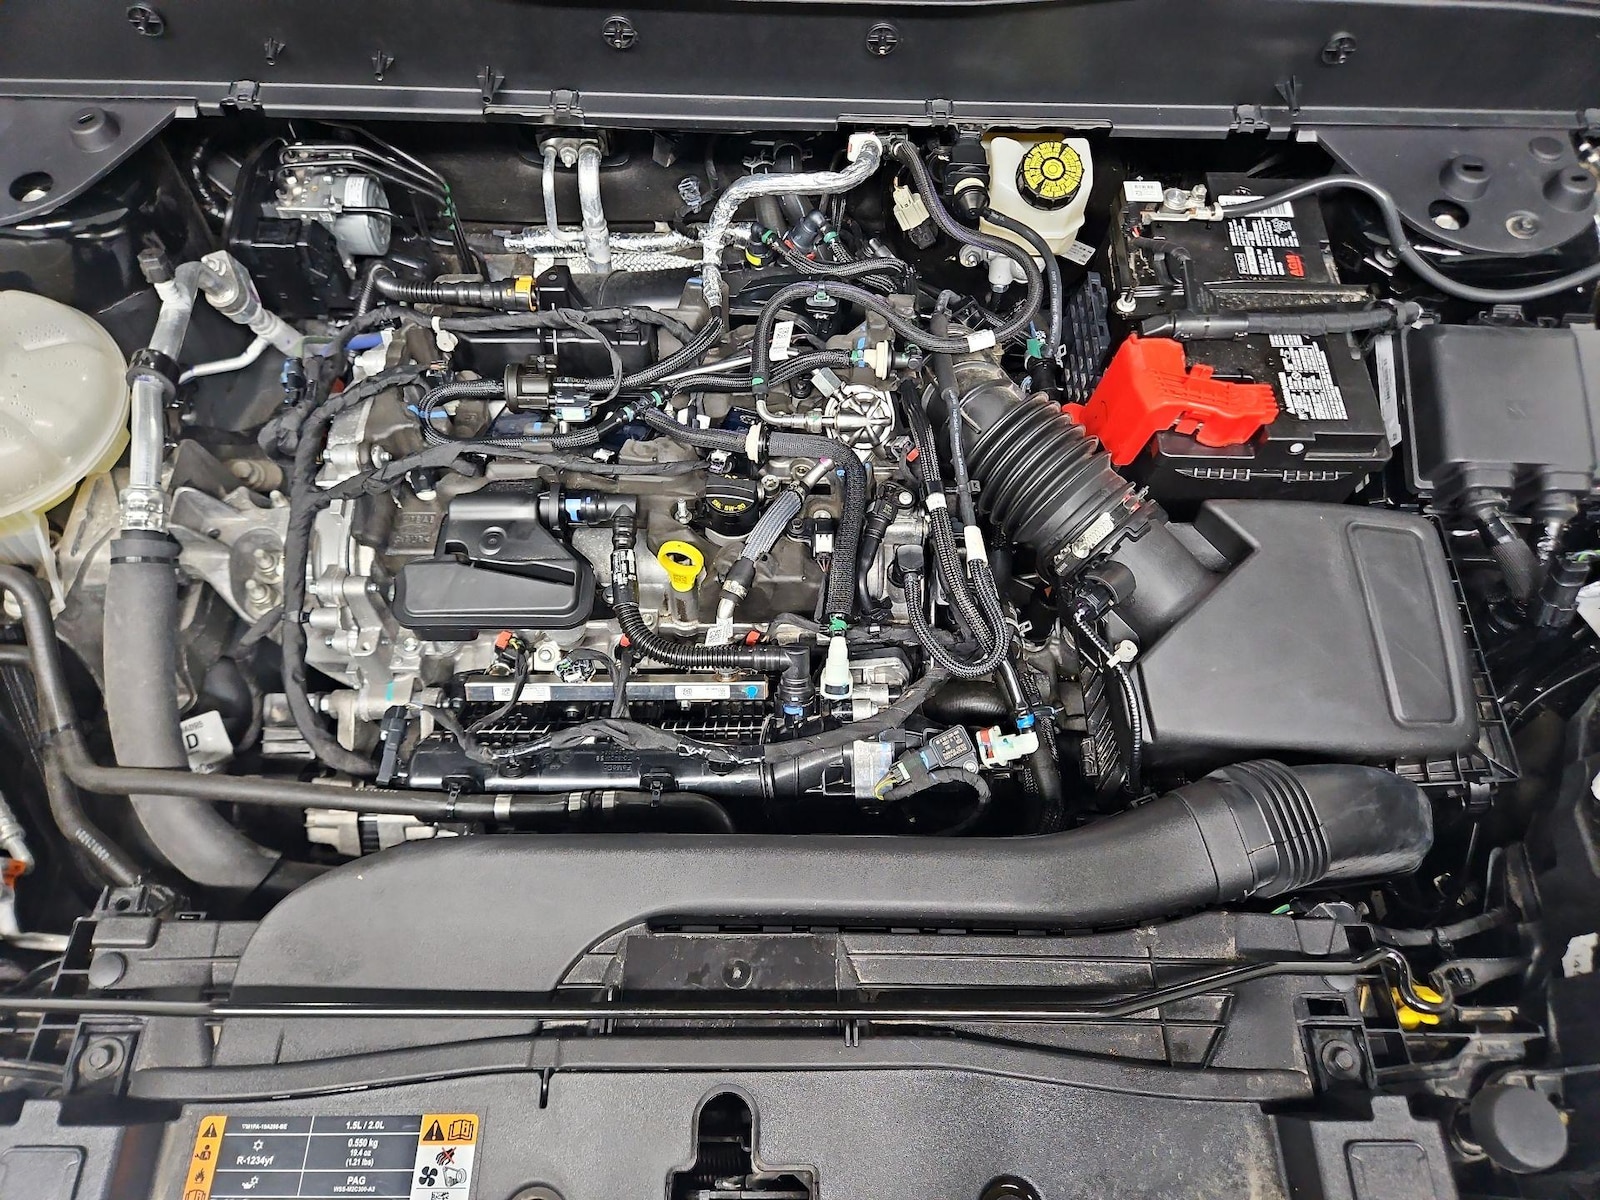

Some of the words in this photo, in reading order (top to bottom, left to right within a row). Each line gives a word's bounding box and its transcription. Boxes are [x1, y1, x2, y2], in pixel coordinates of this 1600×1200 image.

[346, 1121, 362, 1130] 1.5L
[368, 1121, 385, 1130] 2.0L
[348, 1138, 367, 1148] 0.550
[368, 1138, 379, 1150] kg
[236, 1155, 274, 1167] R-1234yf
[347, 1176, 366, 1185] PAG
